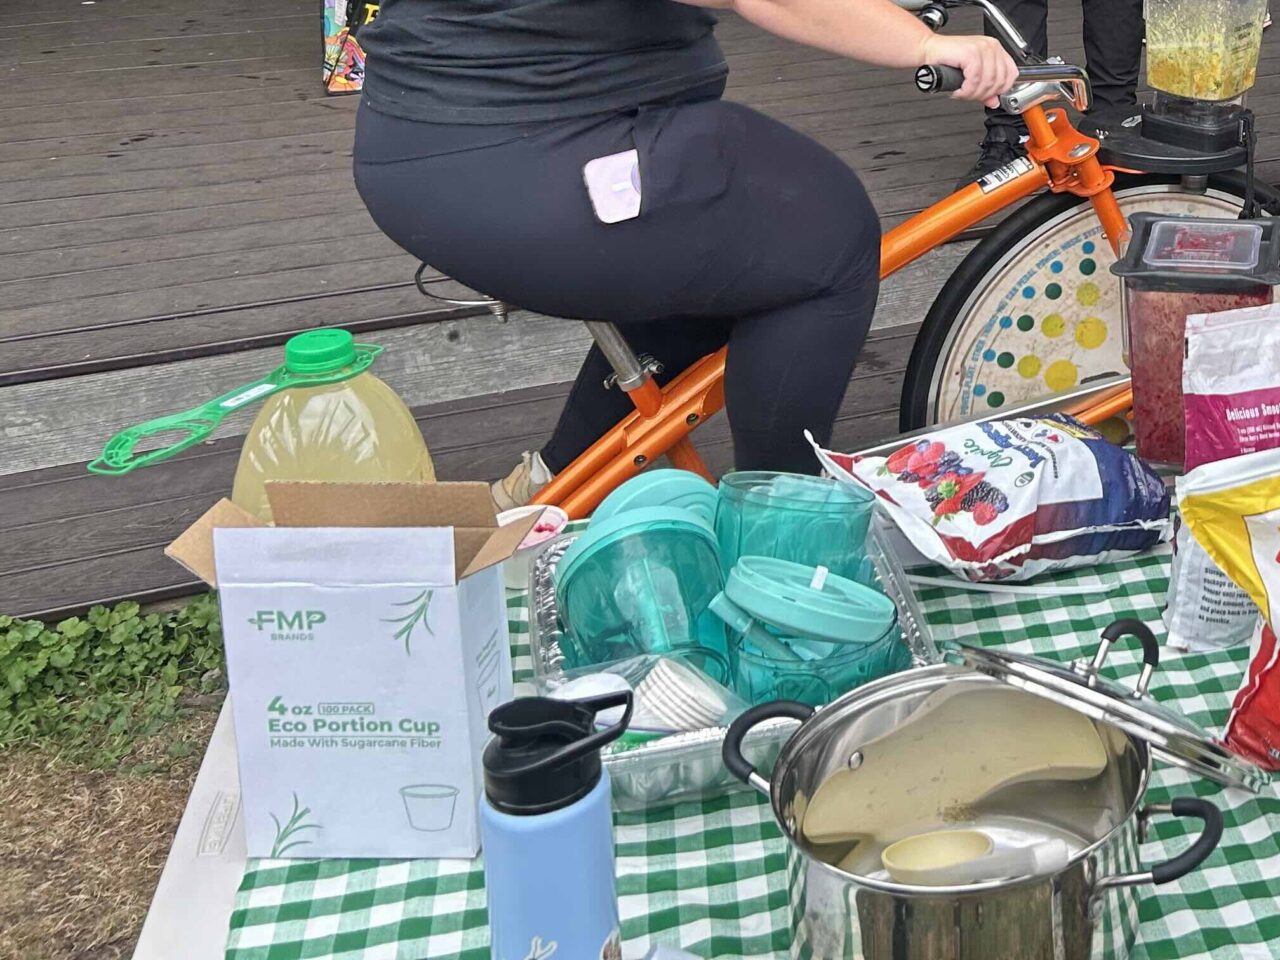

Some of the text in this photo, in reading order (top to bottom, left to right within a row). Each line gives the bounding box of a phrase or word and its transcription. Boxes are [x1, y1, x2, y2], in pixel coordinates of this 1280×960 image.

[1225, 403, 1260, 423] Delicious
[256, 610, 326, 631] FMP
[270, 633, 315, 641] BRANDS
[267, 695, 288, 715] 4
[291, 705, 313, 716] oz
[342, 705, 373, 714] PACK
[268, 717, 441, 737] Eco Portion Cup
[270, 738, 442, 750] Made With Sugarcane Fiber
